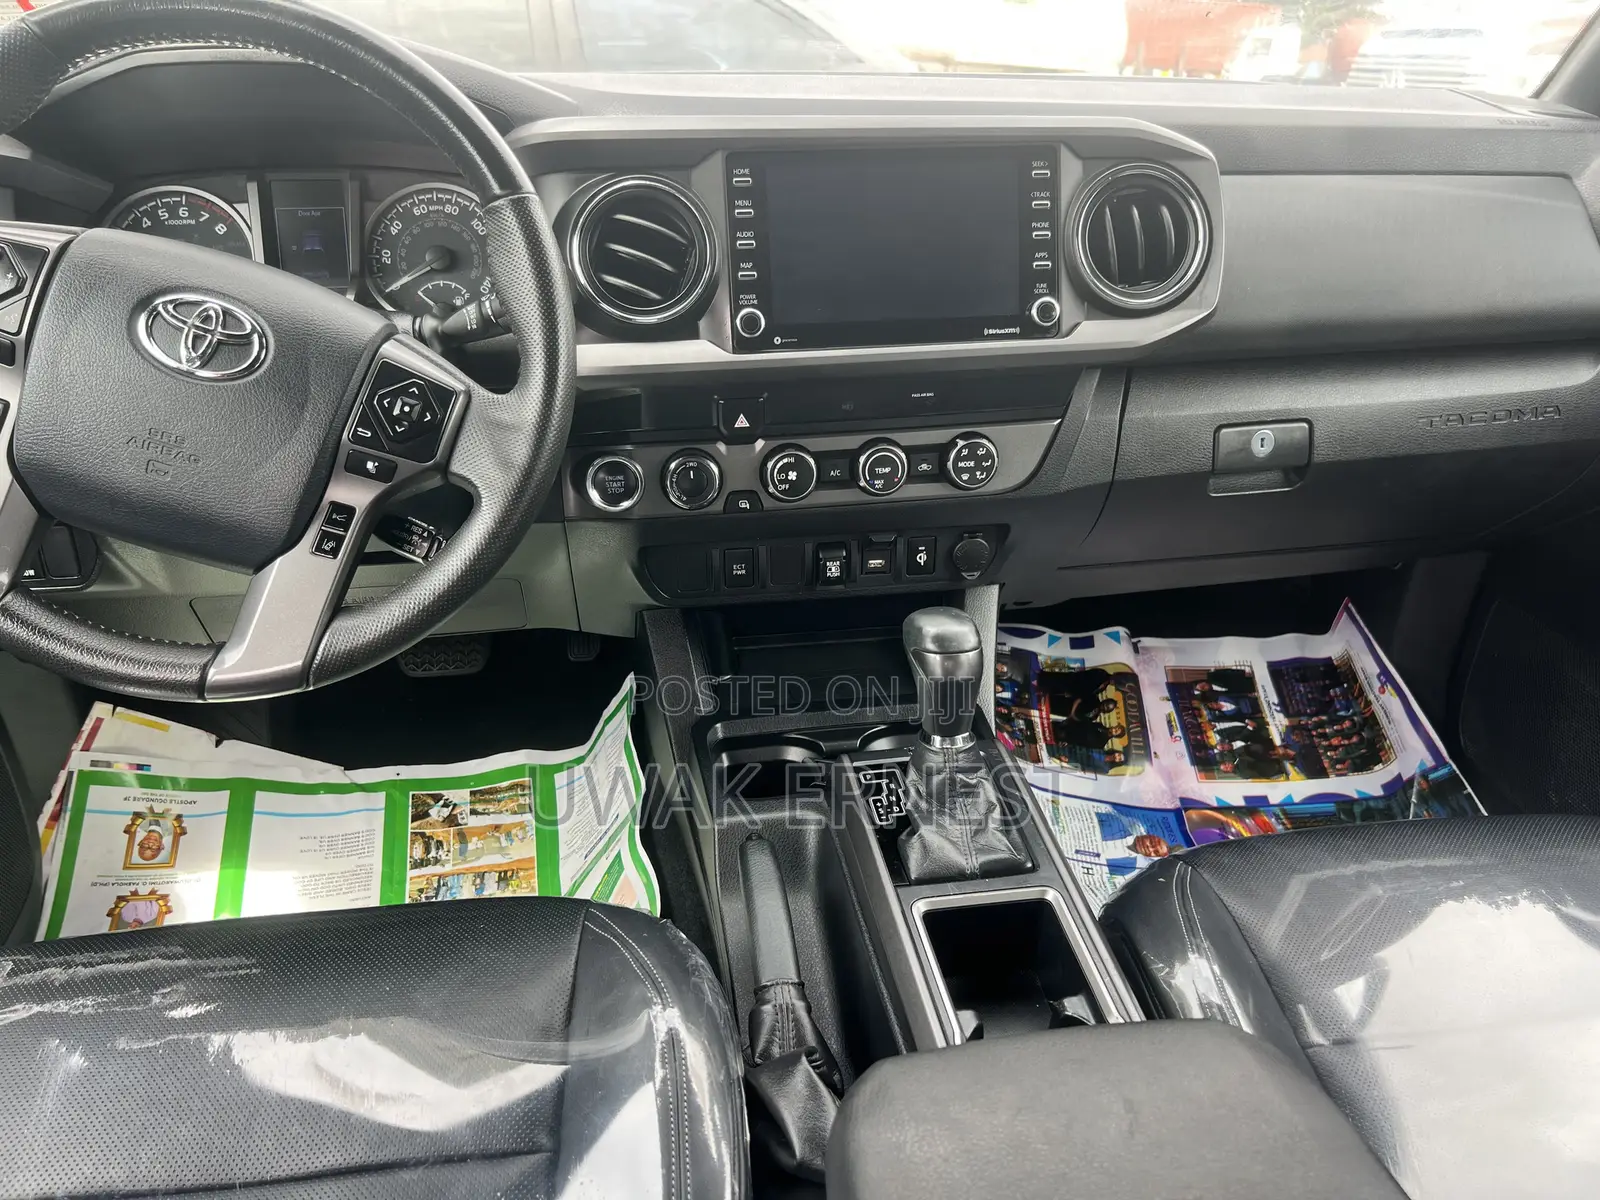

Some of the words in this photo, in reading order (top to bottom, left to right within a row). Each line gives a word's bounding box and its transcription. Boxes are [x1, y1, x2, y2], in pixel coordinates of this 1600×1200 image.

[158, 209, 168, 220] 5
[179, 207, 188, 218] 6
[413, 204, 428, 216] 60
[444, 204, 459, 216] 80
[142, 216, 152, 228] 4
[199, 211, 210, 222] 7
[214, 223, 227, 234] 8
[390, 220, 402, 236] 40
[471, 218, 486, 236] 100
[382, 249, 391, 264] 20
[1418, 404, 1562, 430] TACOMA
